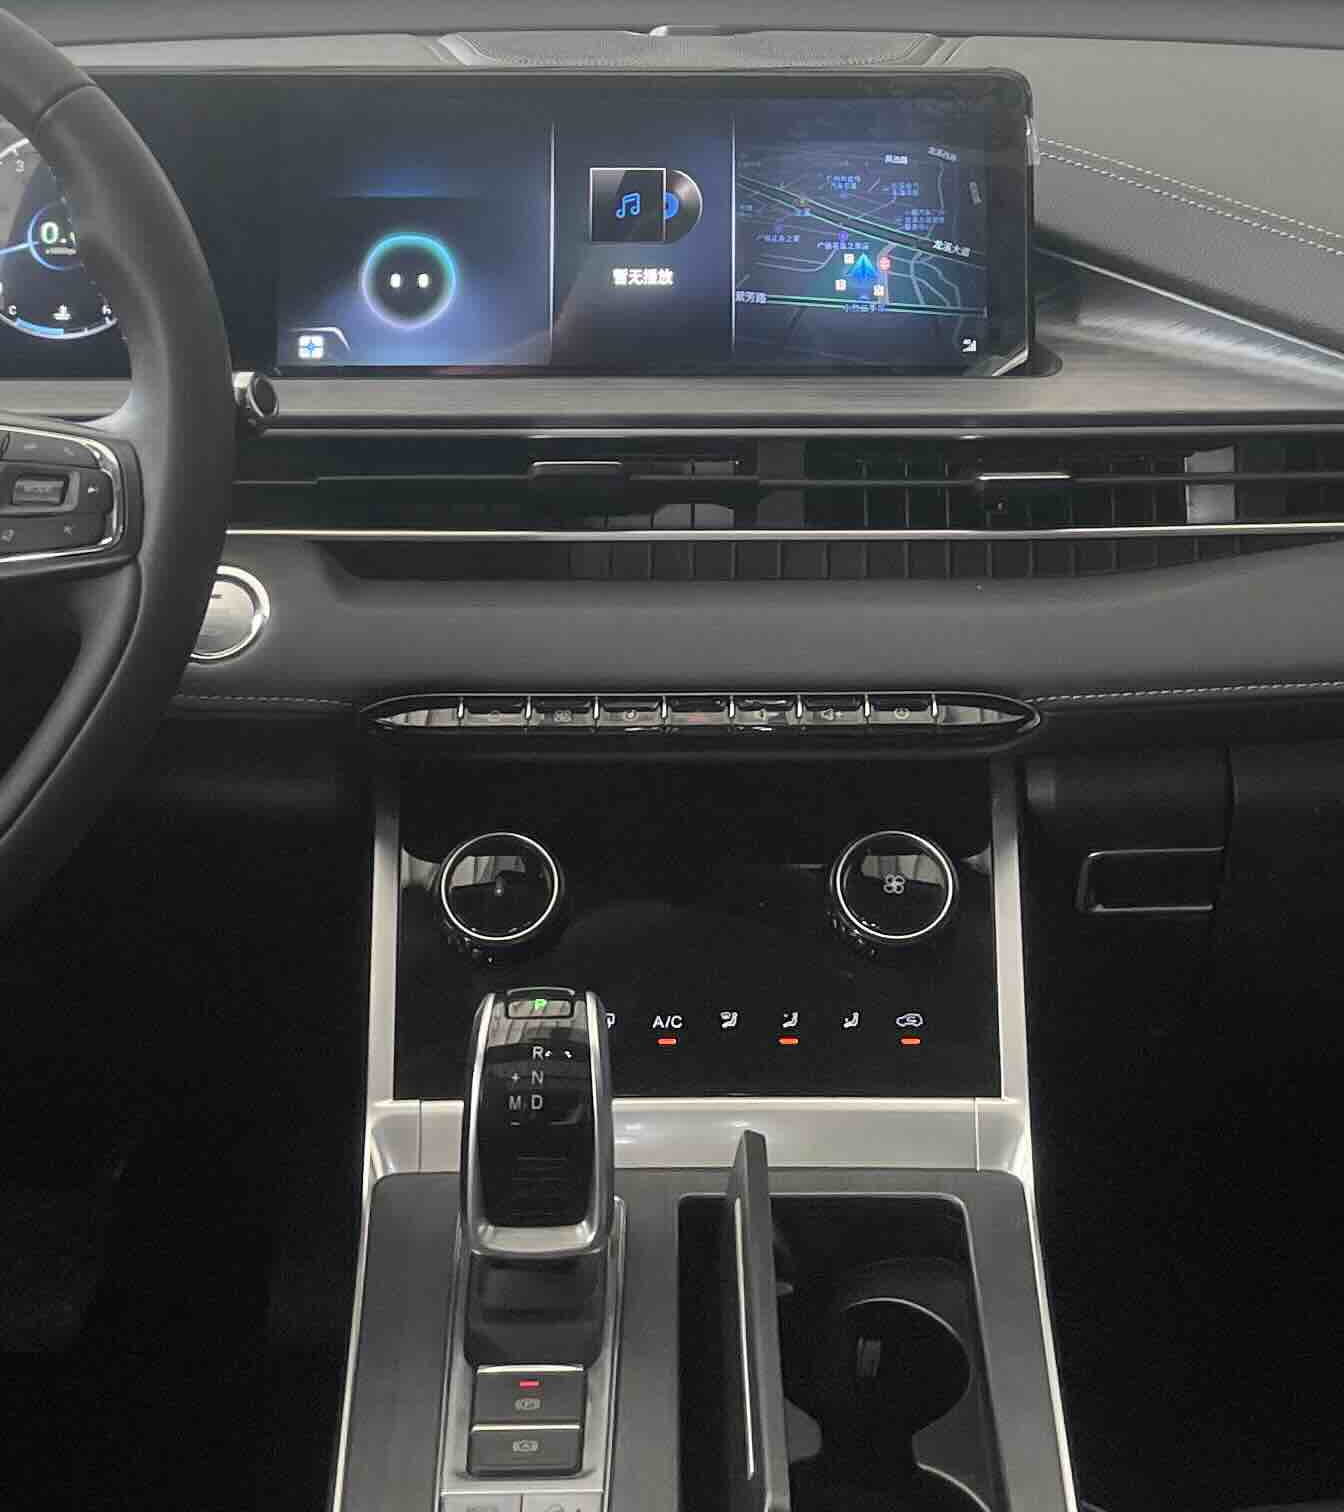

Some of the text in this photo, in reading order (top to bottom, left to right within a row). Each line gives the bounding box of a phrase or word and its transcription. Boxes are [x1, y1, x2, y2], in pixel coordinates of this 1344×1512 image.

[15, 160, 25, 172] 3
[613, 268, 674, 285] 暂无播放
[8, 306, 17, 316] C
[535, 999, 546, 1010] P
[652, 1015, 683, 1029] A/C
[532, 1046, 544, 1061] R
[531, 1070, 544, 1085] N
[508, 1094, 543, 1110] M D
